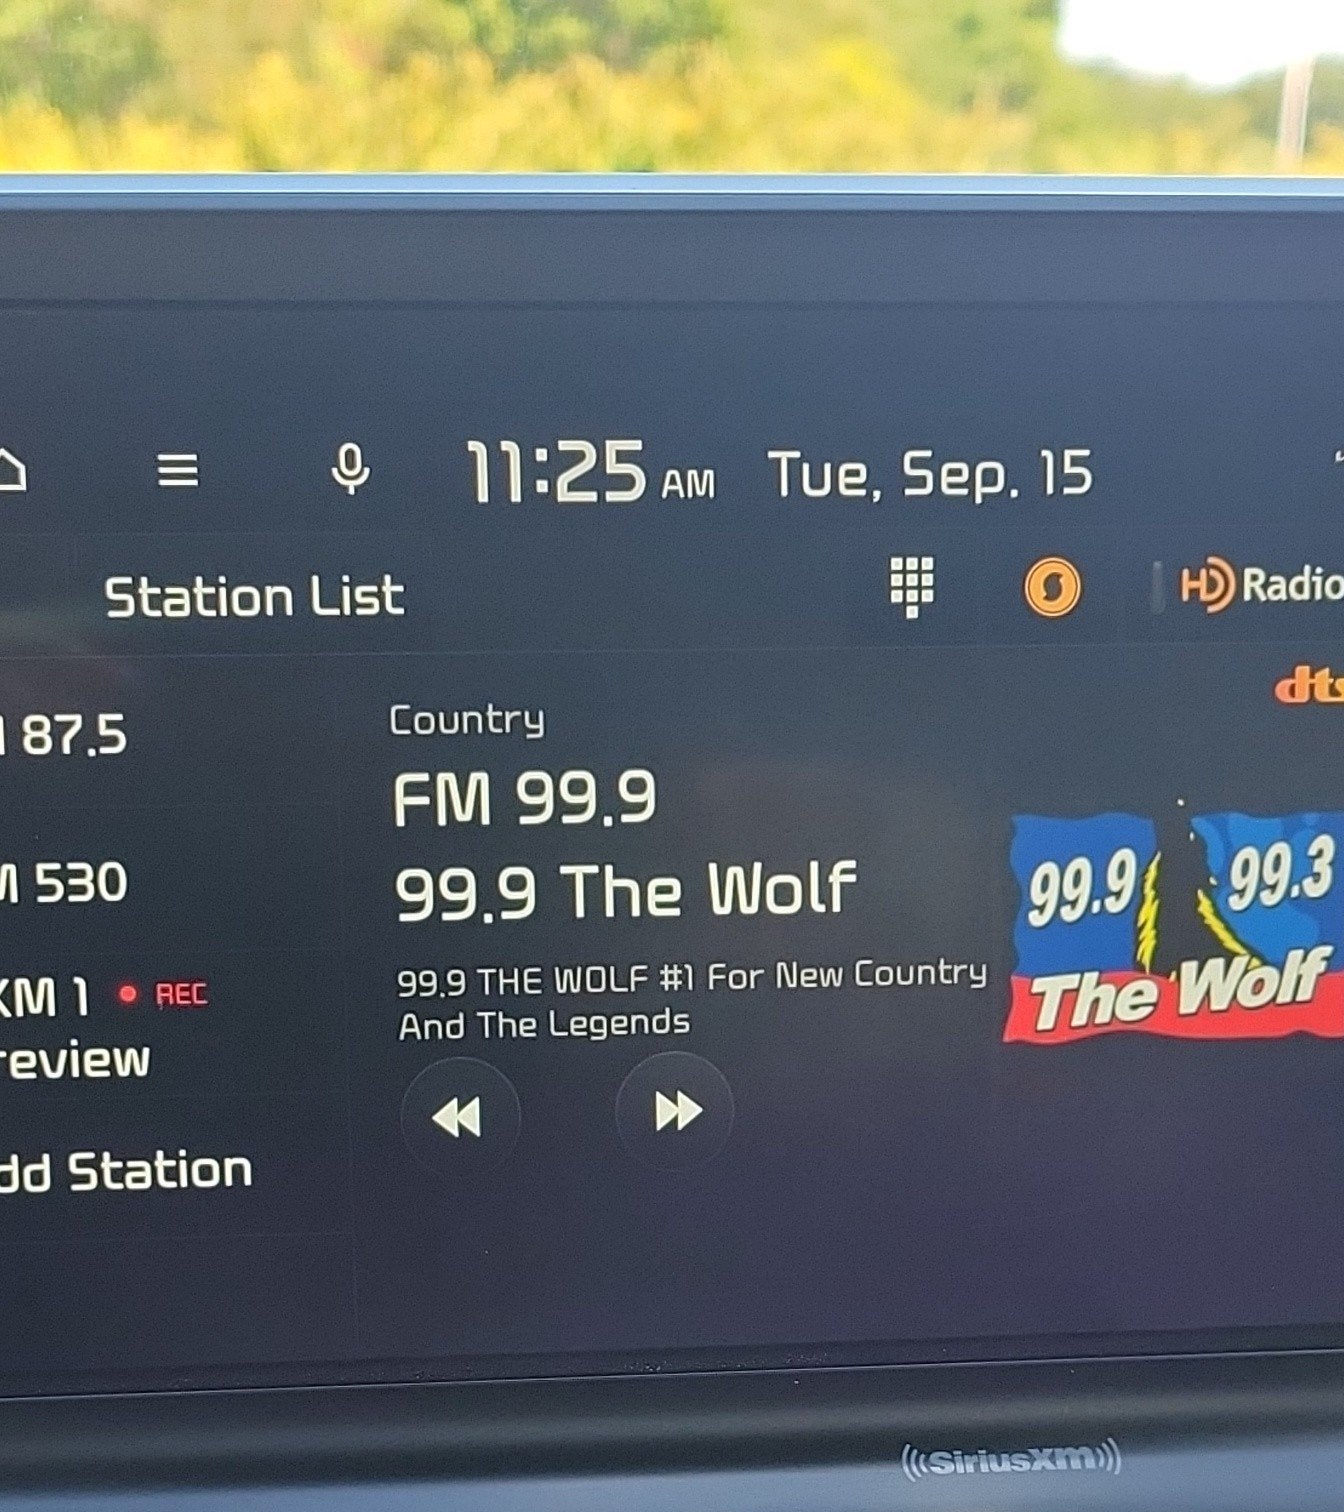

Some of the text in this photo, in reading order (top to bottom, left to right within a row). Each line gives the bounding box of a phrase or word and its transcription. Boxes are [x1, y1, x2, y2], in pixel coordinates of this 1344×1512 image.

[466, 439, 1093, 504] 11:25 AM Tue, Sep. 15
[105, 576, 294, 618] Station
[310, 573, 405, 616] List
[1181, 556, 1236, 614] HD
[22, 713, 128, 757] 87.5
[389, 703, 546, 739] Country
[394, 768, 656, 827] FM 99.9
[34, 861, 128, 902] 530
[395, 860, 858, 924] 99.9 The Wolf
[1028, 834, 1336, 928] 99.9 99.3
[72, 976, 88, 1016] 1
[156, 982, 208, 1006] REC
[396, 958, 988, 999] 99.9 THE WOLF #1 For New Country
[1031, 944, 1334, 1032] The Wolf
[399, 1008, 691, 1041] And The Legends
[69, 1149, 254, 1192] Station
